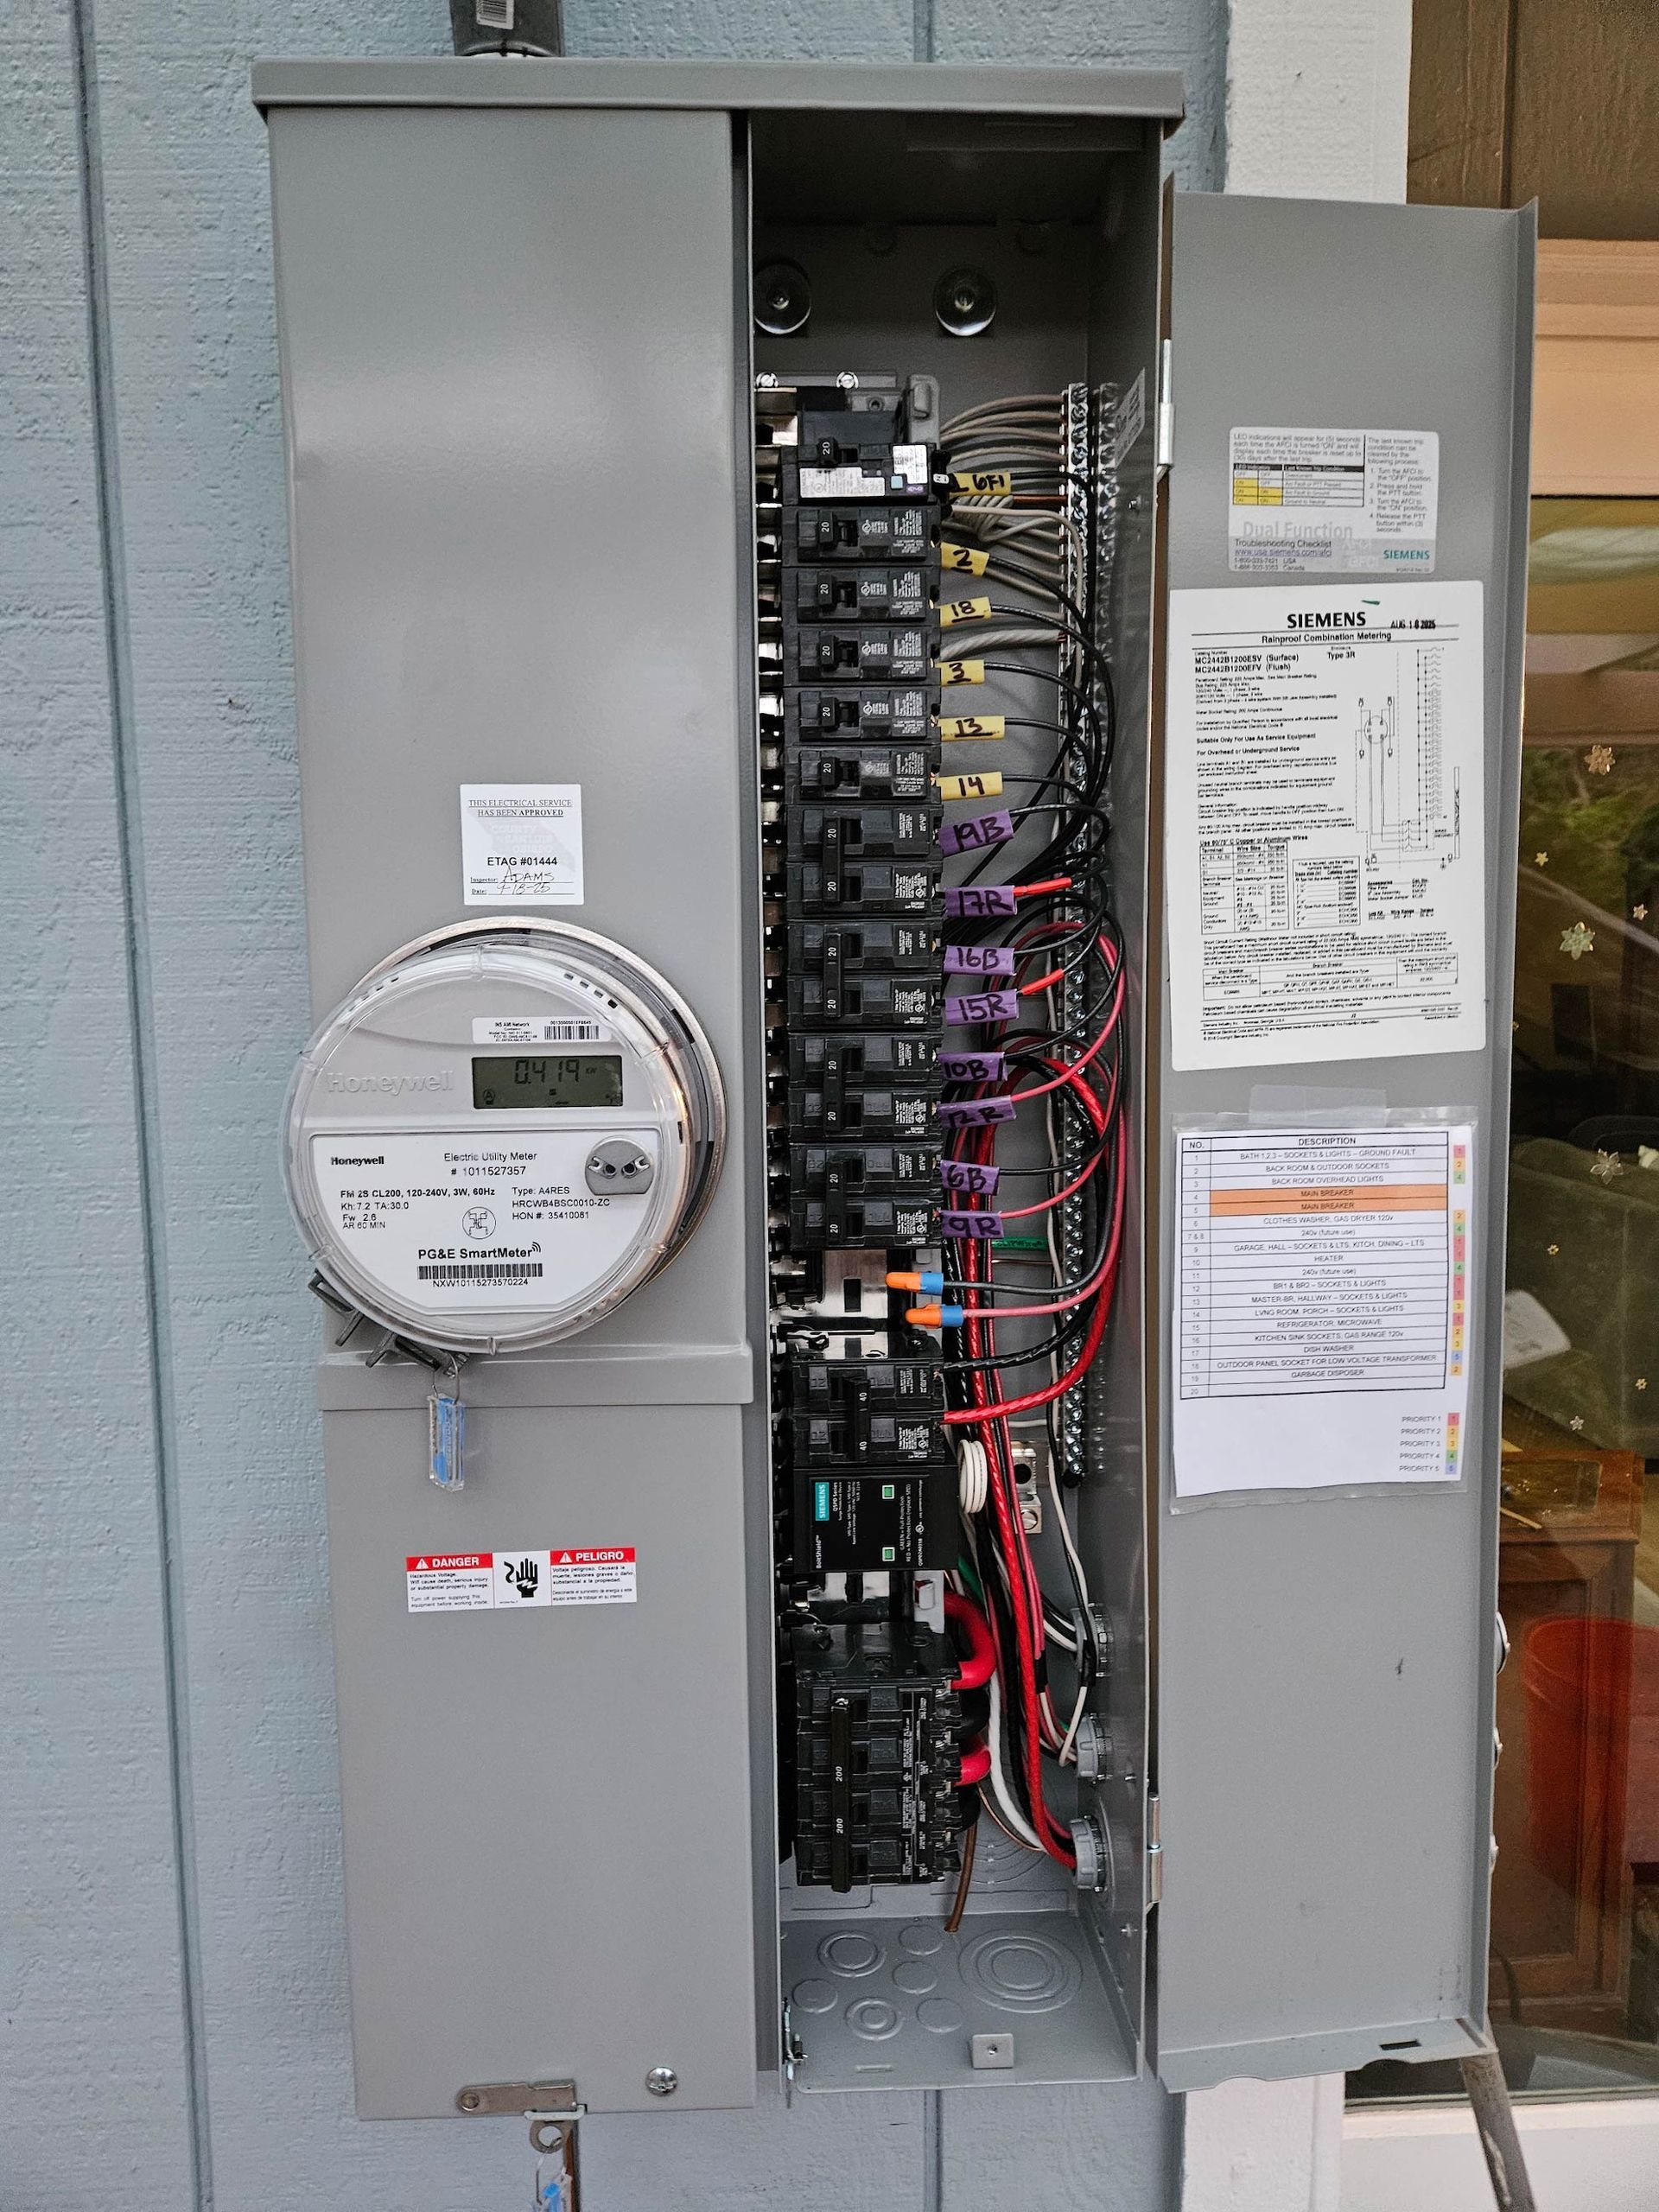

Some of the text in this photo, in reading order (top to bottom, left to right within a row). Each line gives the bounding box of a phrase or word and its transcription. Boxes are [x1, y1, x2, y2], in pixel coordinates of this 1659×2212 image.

[822, 521, 830, 533] 20
[1243, 521, 1353, 539] Dual Function
[1236, 538, 1294, 549] Troubleshooting
[952, 549, 973, 567] 2
[1383, 550, 1430, 560] SIEMENS
[820, 583, 829, 595] 20
[950, 600, 976, 617] 18
[1287, 611, 1367, 629] SIEMENS
[1262, 632, 1391, 645] Rainproof Combination Metering
[822, 645, 830, 657] 20
[1327, 652, 1344, 660] Type
[1266, 654, 1299, 663] (Surface)
[948, 662, 967, 679] 3
[822, 706, 830, 717] 20
[956, 717, 983, 734] 13
[1243, 747, 1279, 755] Underground
[823, 763, 831, 773] 20
[957, 775, 985, 797] 14
[828, 828, 836, 839] 20
[487, 856, 558, 866] ETAG #01444
[503, 865, 555, 883] ADAMS
[828, 880, 836, 892] 20
[957, 890, 1013, 916] 17R
[828, 946, 836, 957] 20
[828, 998, 836, 1010] 20
[958, 994, 1007, 1020] 15R
[829, 1059, 837, 1071] 20
[944, 1058, 988, 1081] 10B
[514, 1059, 580, 1084] 0.419
[327, 1071, 454, 1096] Honeywell
[828, 1110, 836, 1122] 20
[1299, 1137, 1356, 1146] DESCRIPTION
[331, 1155, 385, 1166] Honeywell
[444, 1152, 537, 1162] Electric Utility Meter
[463, 1166, 526, 1176] 1011527357
[830, 1173, 838, 1184] 20
[947, 1165, 986, 1190] 6B
[372, 1189, 404, 1198] CL200,
[407, 1188, 451, 1198] 120-240V,
[453, 1188, 470, 1197] 3W,
[473, 1187, 495, 1196] 60Hz
[512, 1186, 570, 1196] Type: A4RES
[512, 1211, 534, 1220] HON
[830, 1223, 838, 1234] 20
[949, 1216, 1002, 1236] 9R
[418, 1247, 533, 1260] PG&E SmartMeter
[1382, 1354, 1437, 1363] TRANSFORMER
[859, 1391, 867, 1402] 40
[859, 1440, 867, 1452] 40
[432, 1556, 480, 1568] DANGER
[575, 1551, 624, 1562] PELIGRO
